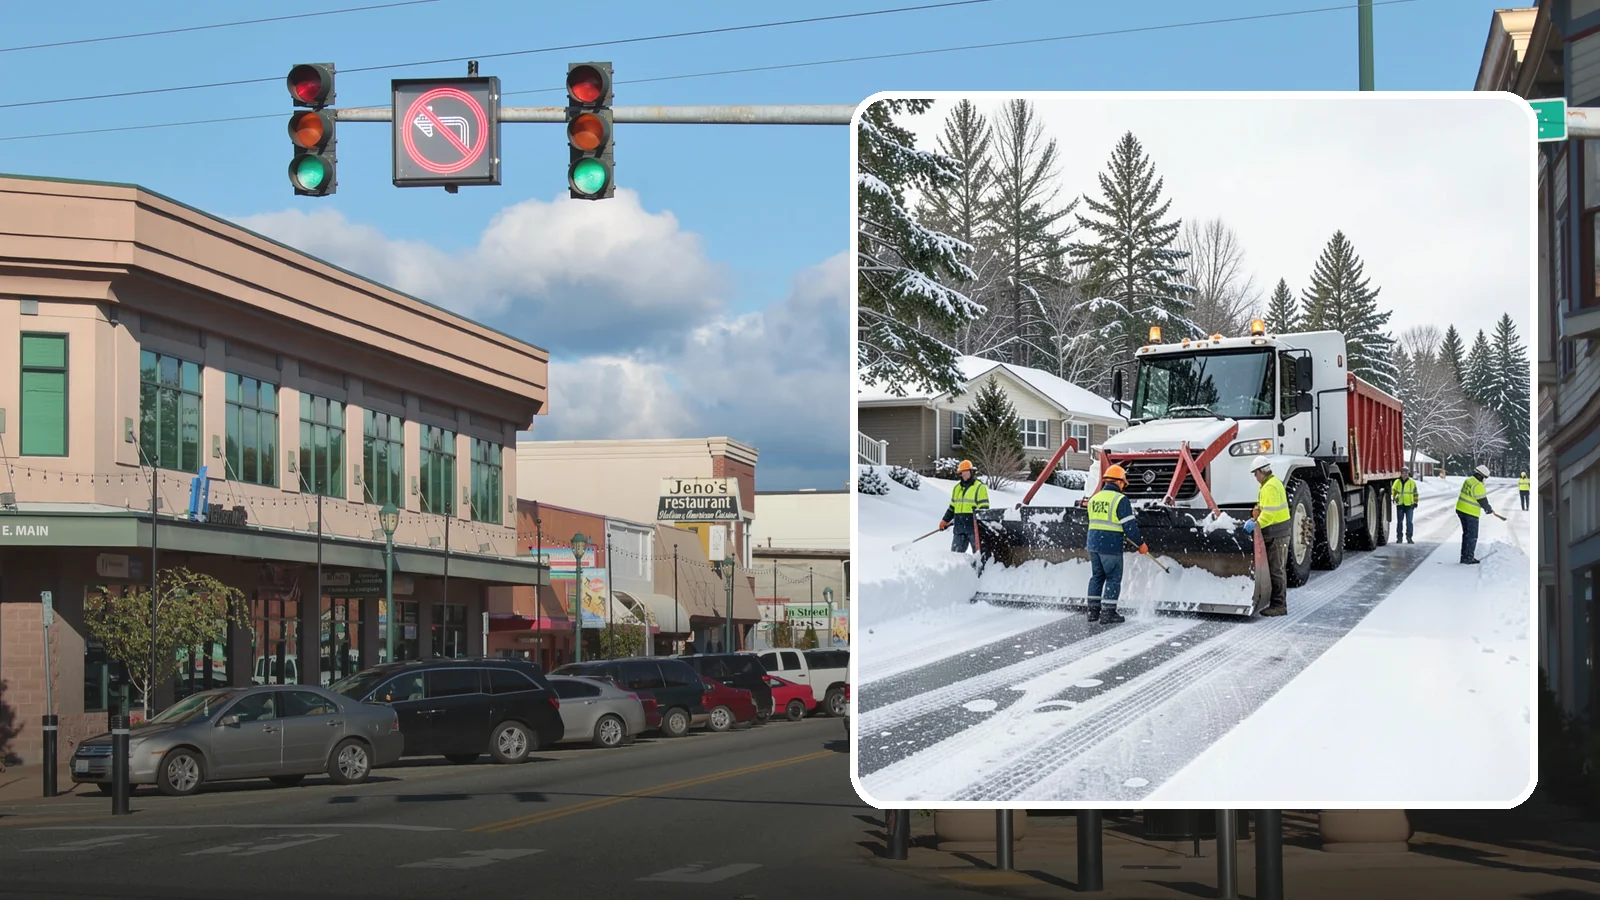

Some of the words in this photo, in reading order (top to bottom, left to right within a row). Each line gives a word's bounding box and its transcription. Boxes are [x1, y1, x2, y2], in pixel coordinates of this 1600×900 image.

[669, 480, 728, 495] Jeno's
[664, 496, 731, 509] restaurant
[658, 509, 681, 519] Italian
[685, 509, 714, 519] American
[715, 509, 738, 519] Cuisine
[2, 525, 13, 536] E.
[15, 525, 49, 536] MAIN
[797, 607, 828, 617] Street
